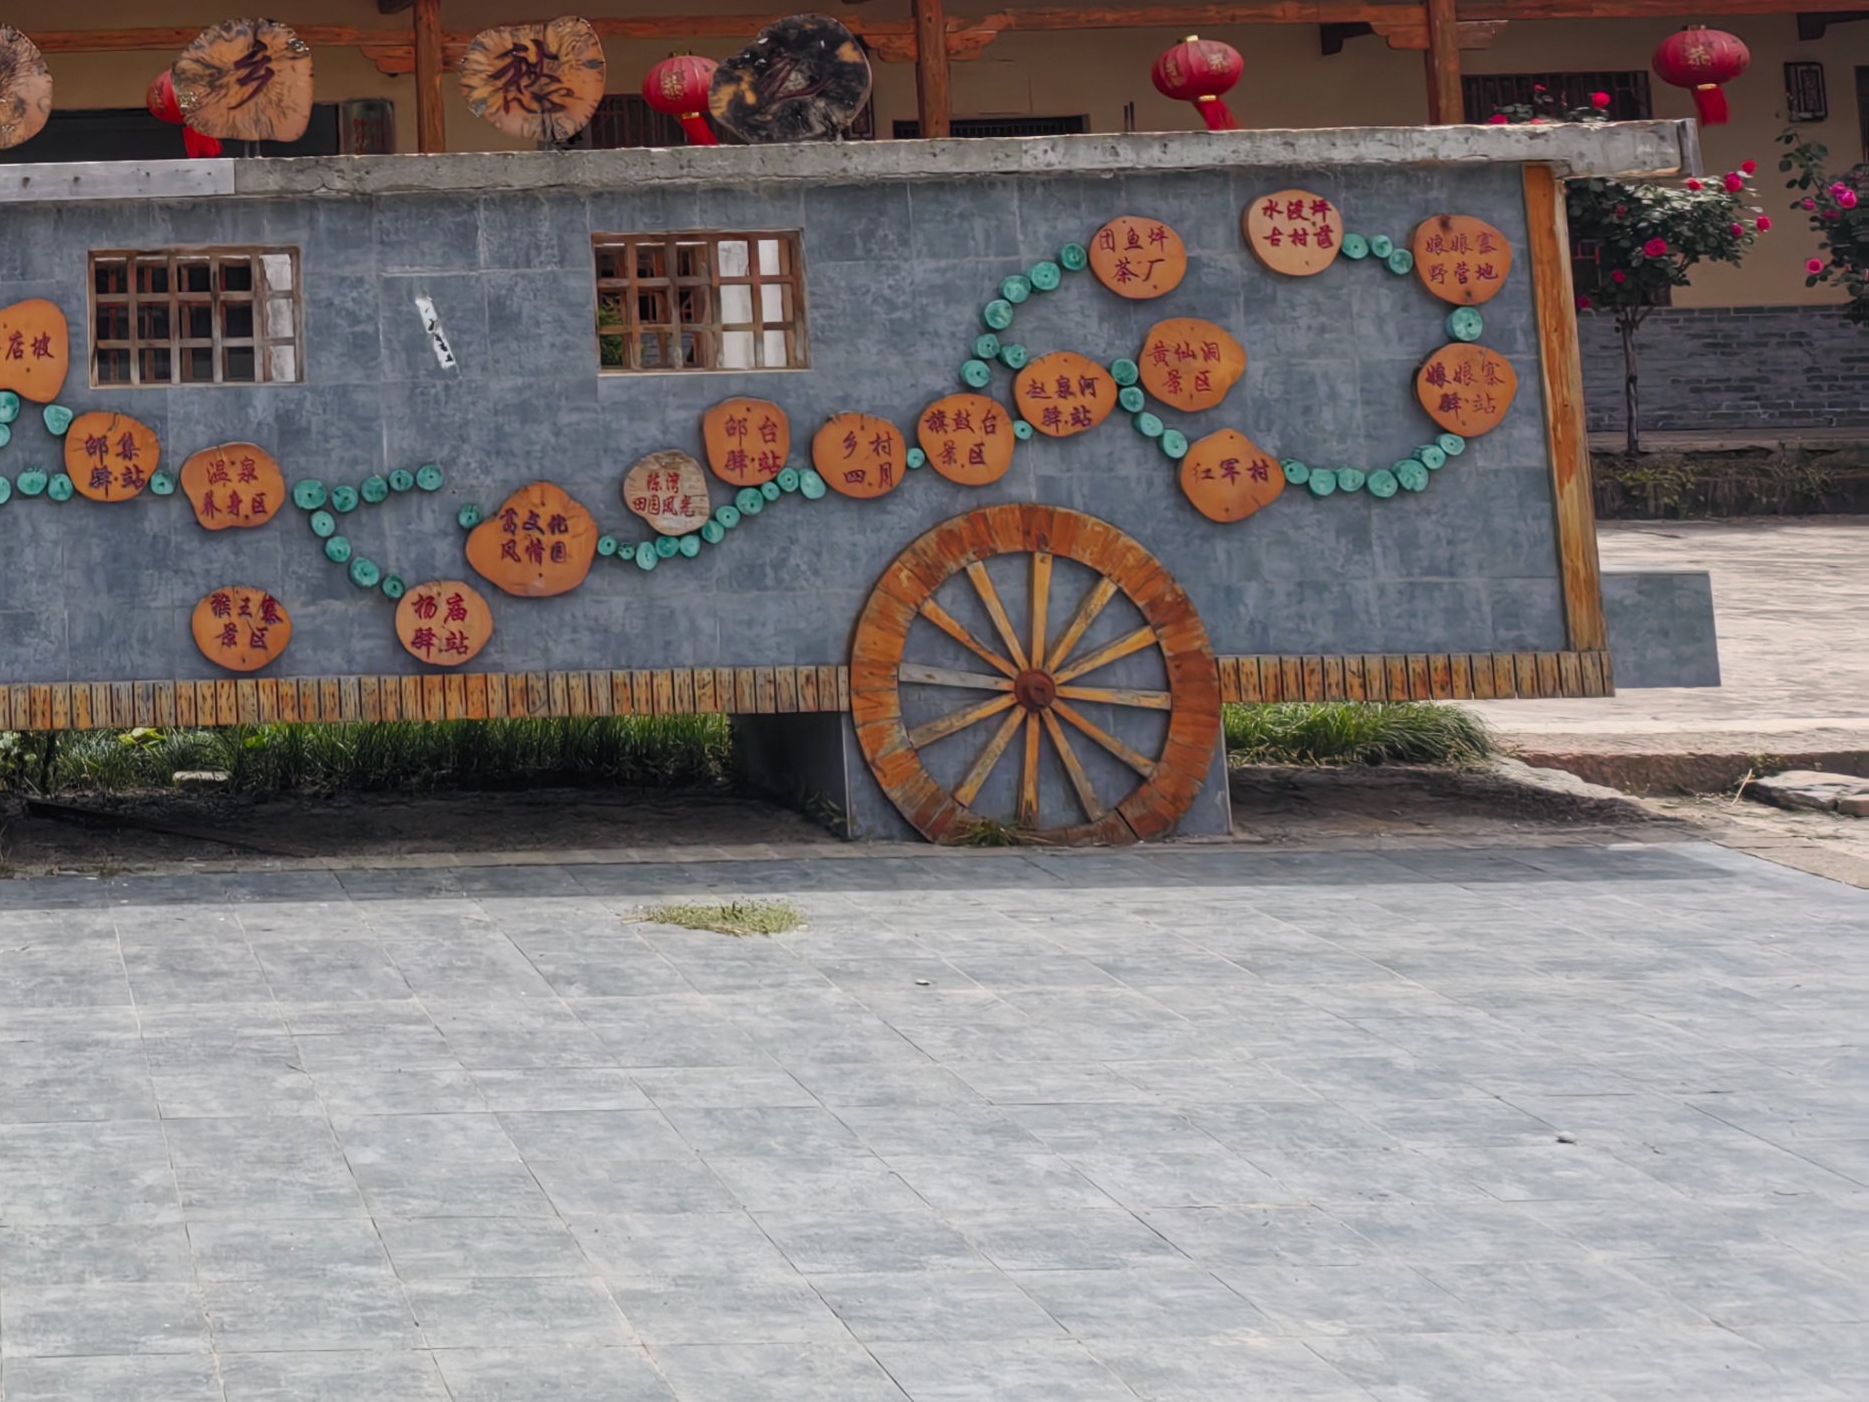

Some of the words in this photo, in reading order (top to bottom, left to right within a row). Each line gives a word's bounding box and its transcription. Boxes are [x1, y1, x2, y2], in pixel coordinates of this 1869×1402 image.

[1099, 228, 1169, 252] 团鱼坪
[1112, 258, 1165, 284] 茶厂
[1429, 262, 1499, 285] 野营地
[1146, 340, 1221, 367] 黄仙洞
[1162, 369, 1213, 394] 景区
[1041, 405, 1093, 433] 驿站
[1438, 392, 1496, 421] 驿站
[842, 430, 892, 458] 乡村
[936, 440, 988, 466] 景区
[206, 456, 258, 484] 温泉
[725, 449, 782, 479] 驿站
[842, 462, 893, 488] 四月
[1192, 458, 1270, 485] 红军村
[89, 466, 145, 498] 驿站
[215, 622, 268, 651] 景区
[410, 627, 469, 658] 驿站
